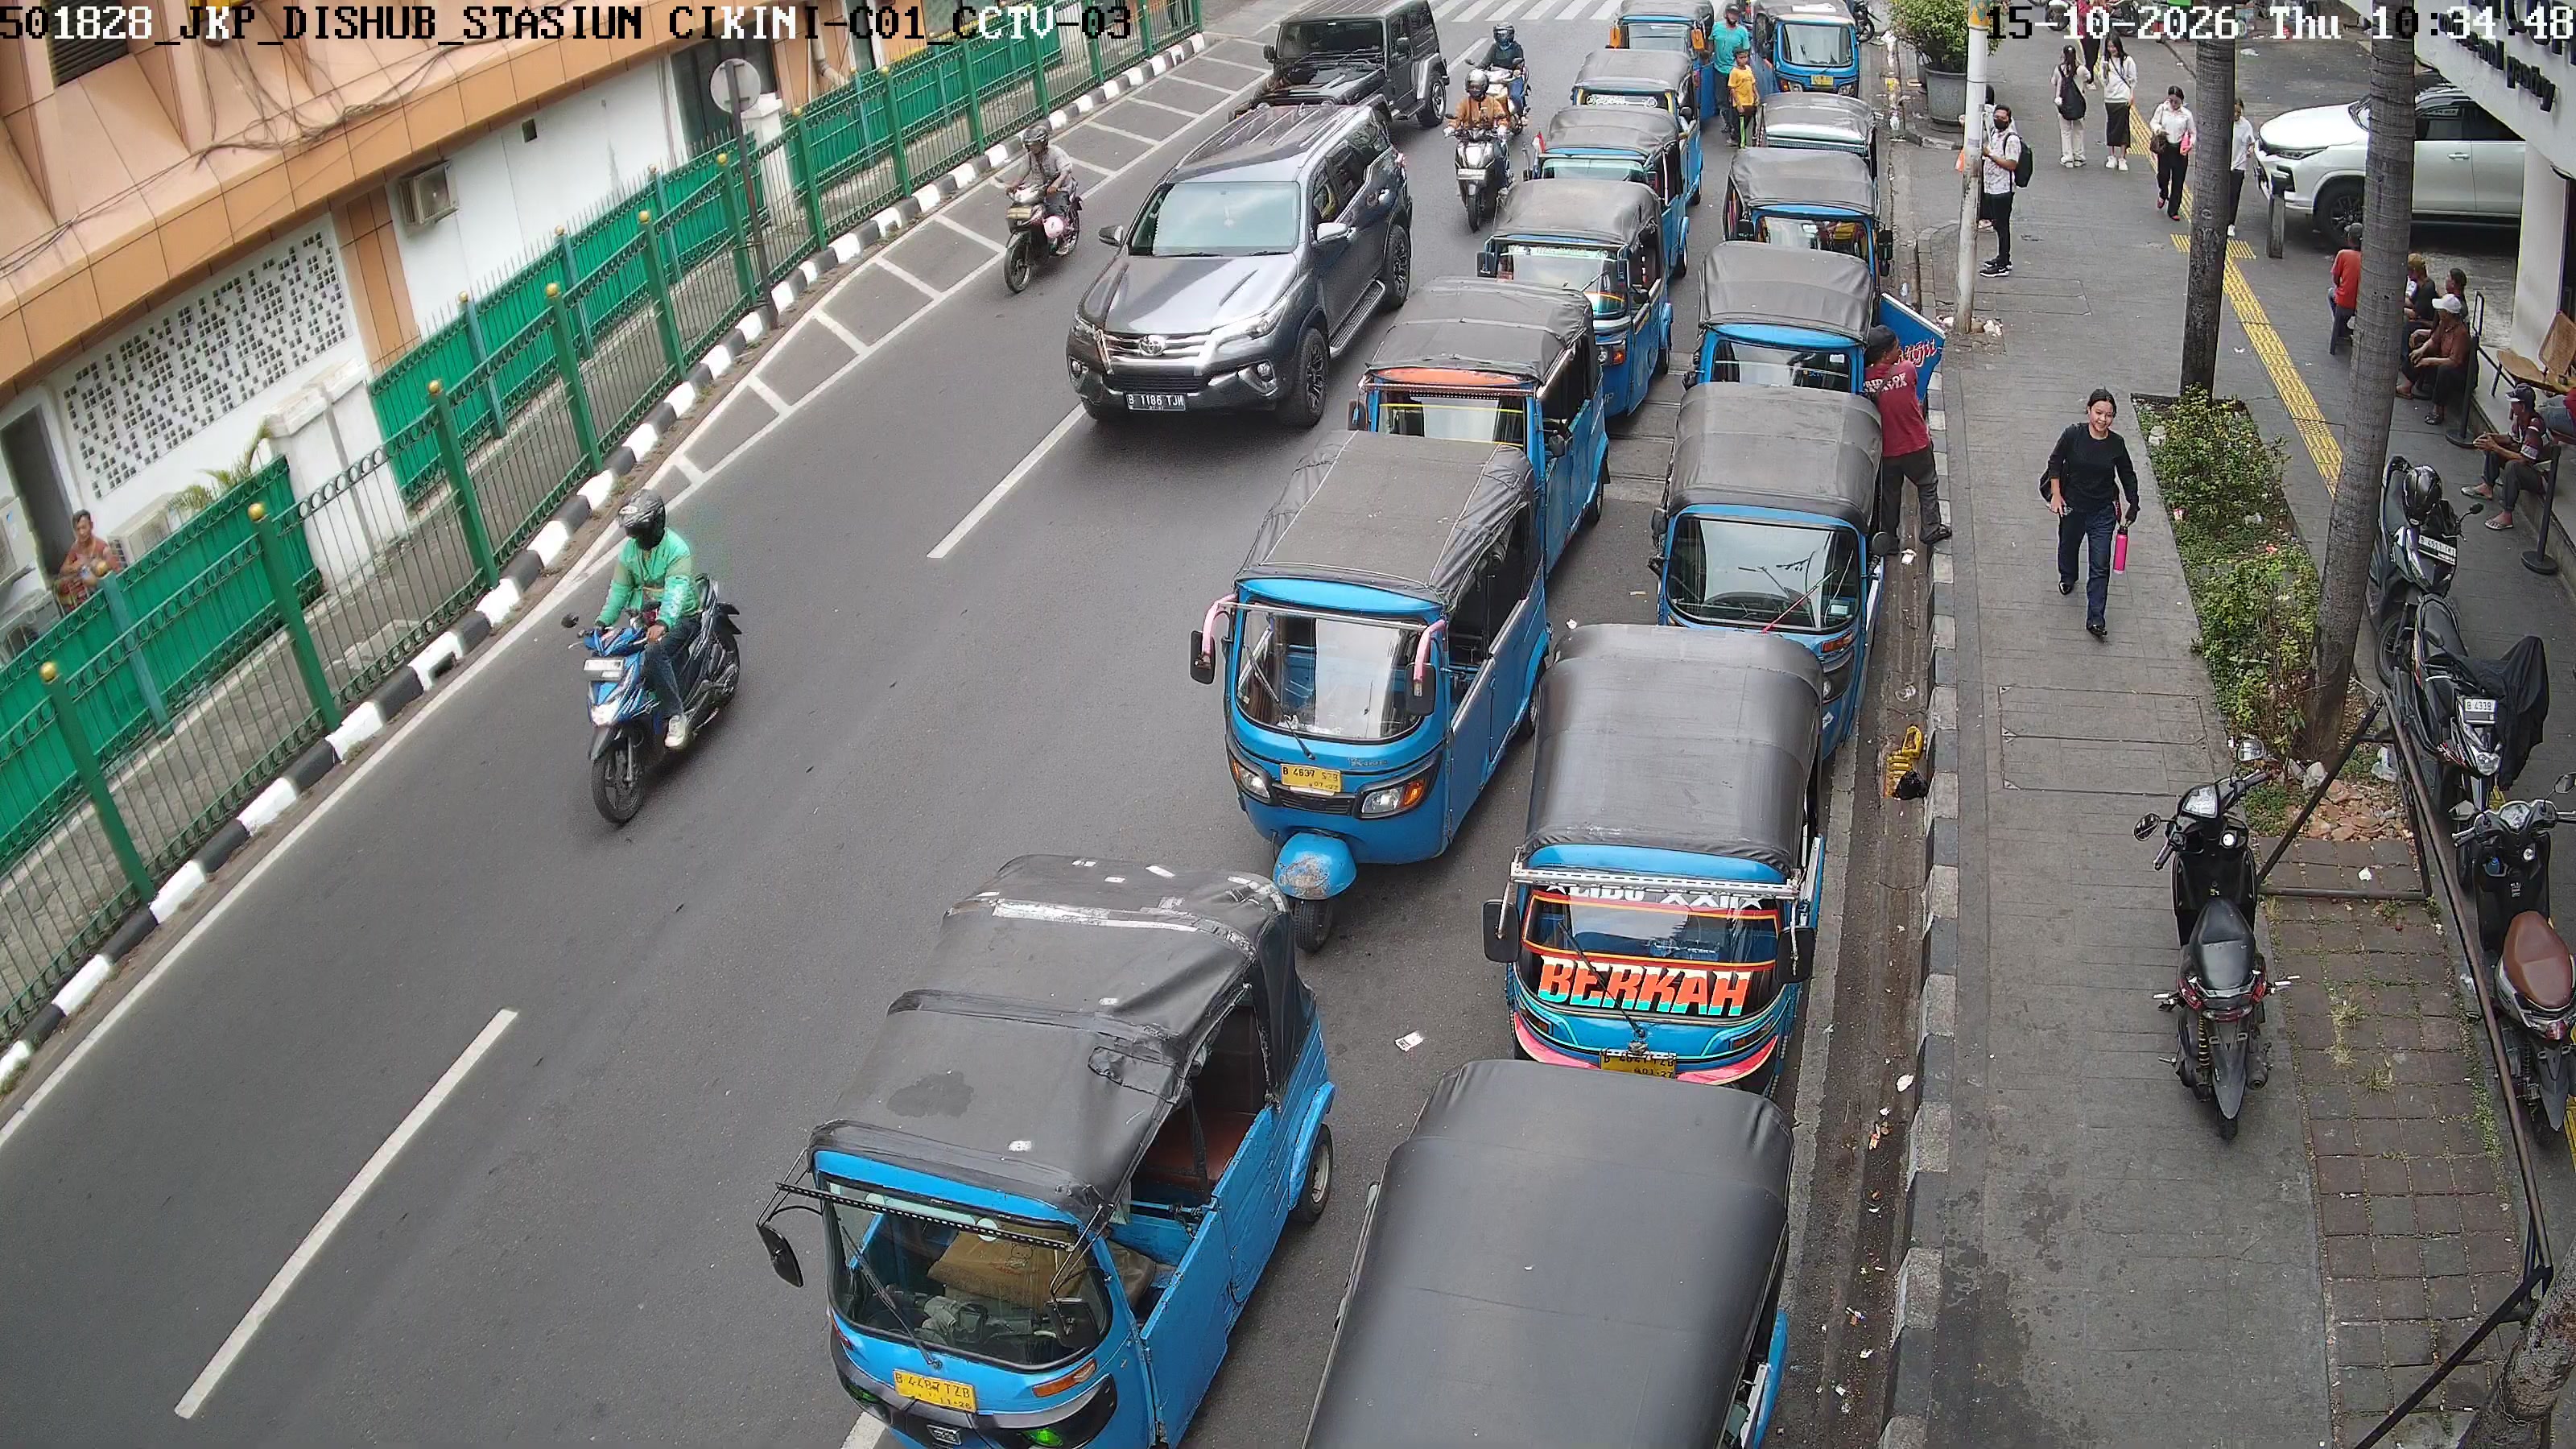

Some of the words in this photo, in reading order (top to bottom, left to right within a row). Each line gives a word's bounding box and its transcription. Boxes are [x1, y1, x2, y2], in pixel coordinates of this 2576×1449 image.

[1128, 394, 1134, 404] B
[1141, 394, 1162, 406] 1186
[1282, 766, 1289, 774] B
[1538, 956, 1752, 1017] BERKAH
[895, 1373, 902, 1384] B
[944, 1383, 970, 1398] TZB
